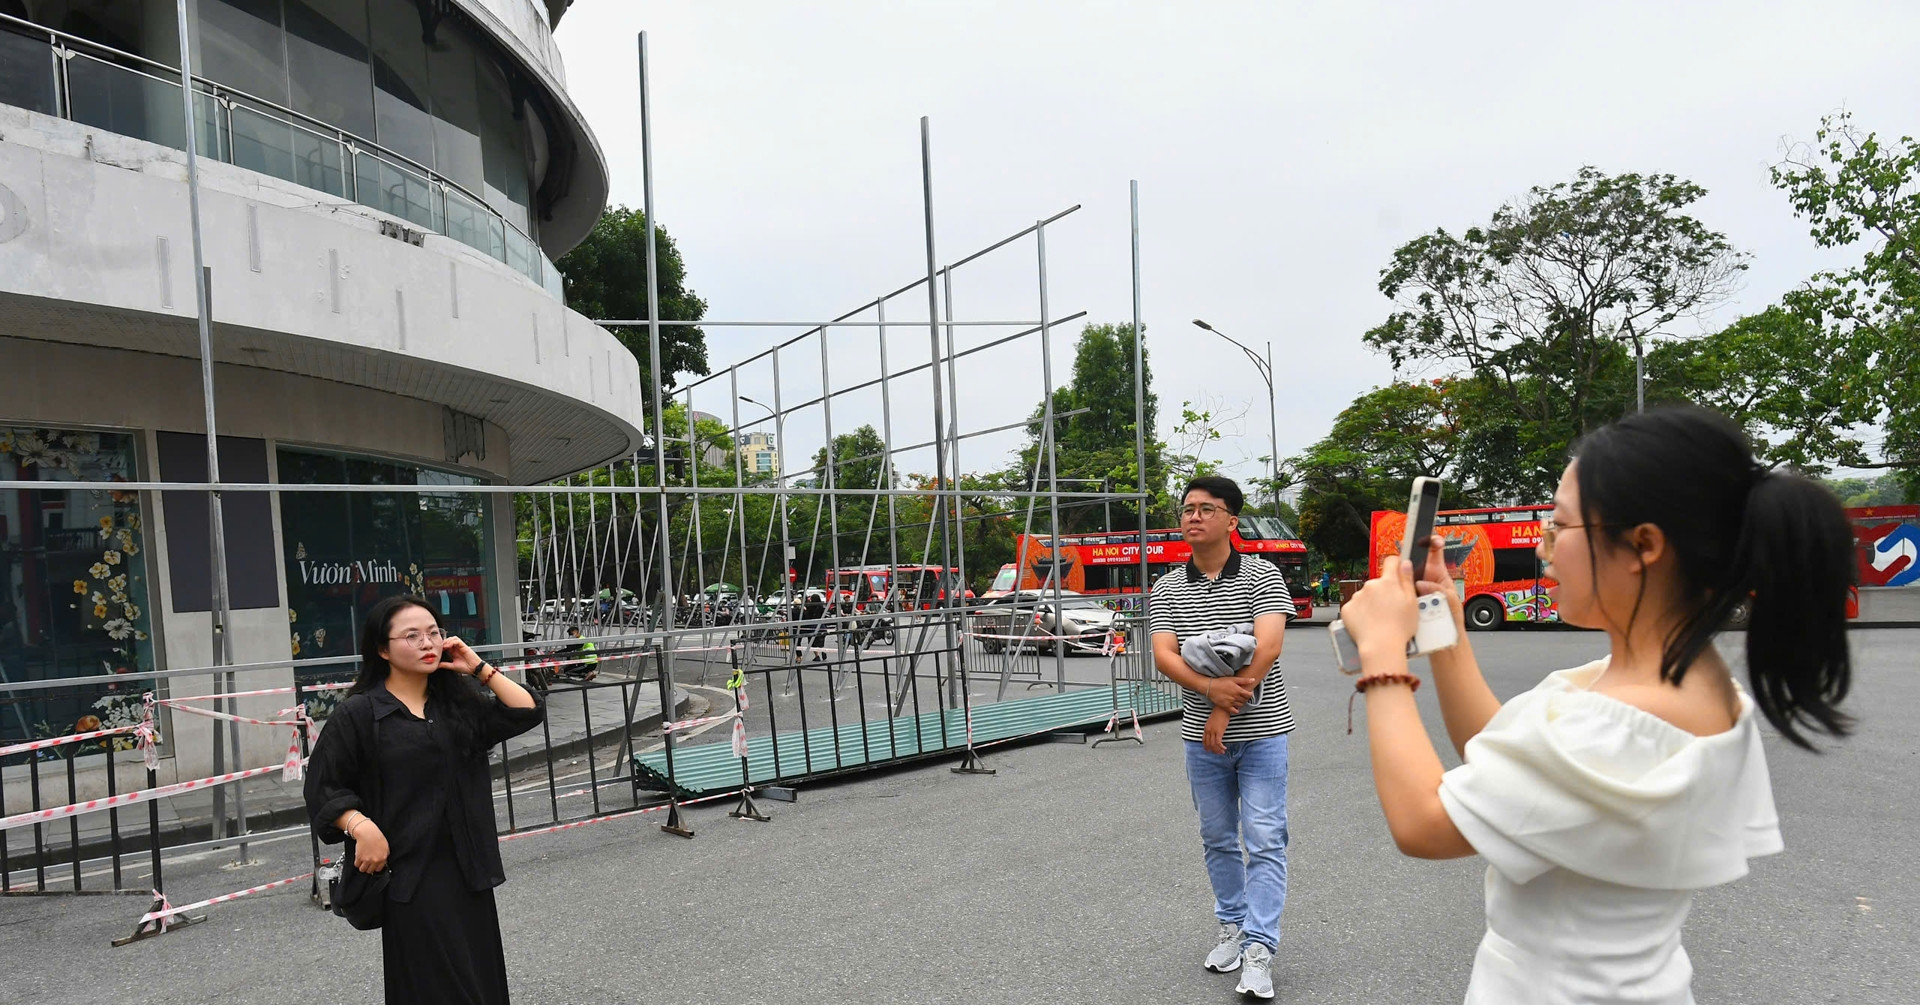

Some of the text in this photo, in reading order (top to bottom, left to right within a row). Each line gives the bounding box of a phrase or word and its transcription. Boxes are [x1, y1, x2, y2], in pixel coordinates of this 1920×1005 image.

[1092, 546, 1164, 556] HA NOI CITY OUR
[299, 558, 398, 584] Vươn Mình
